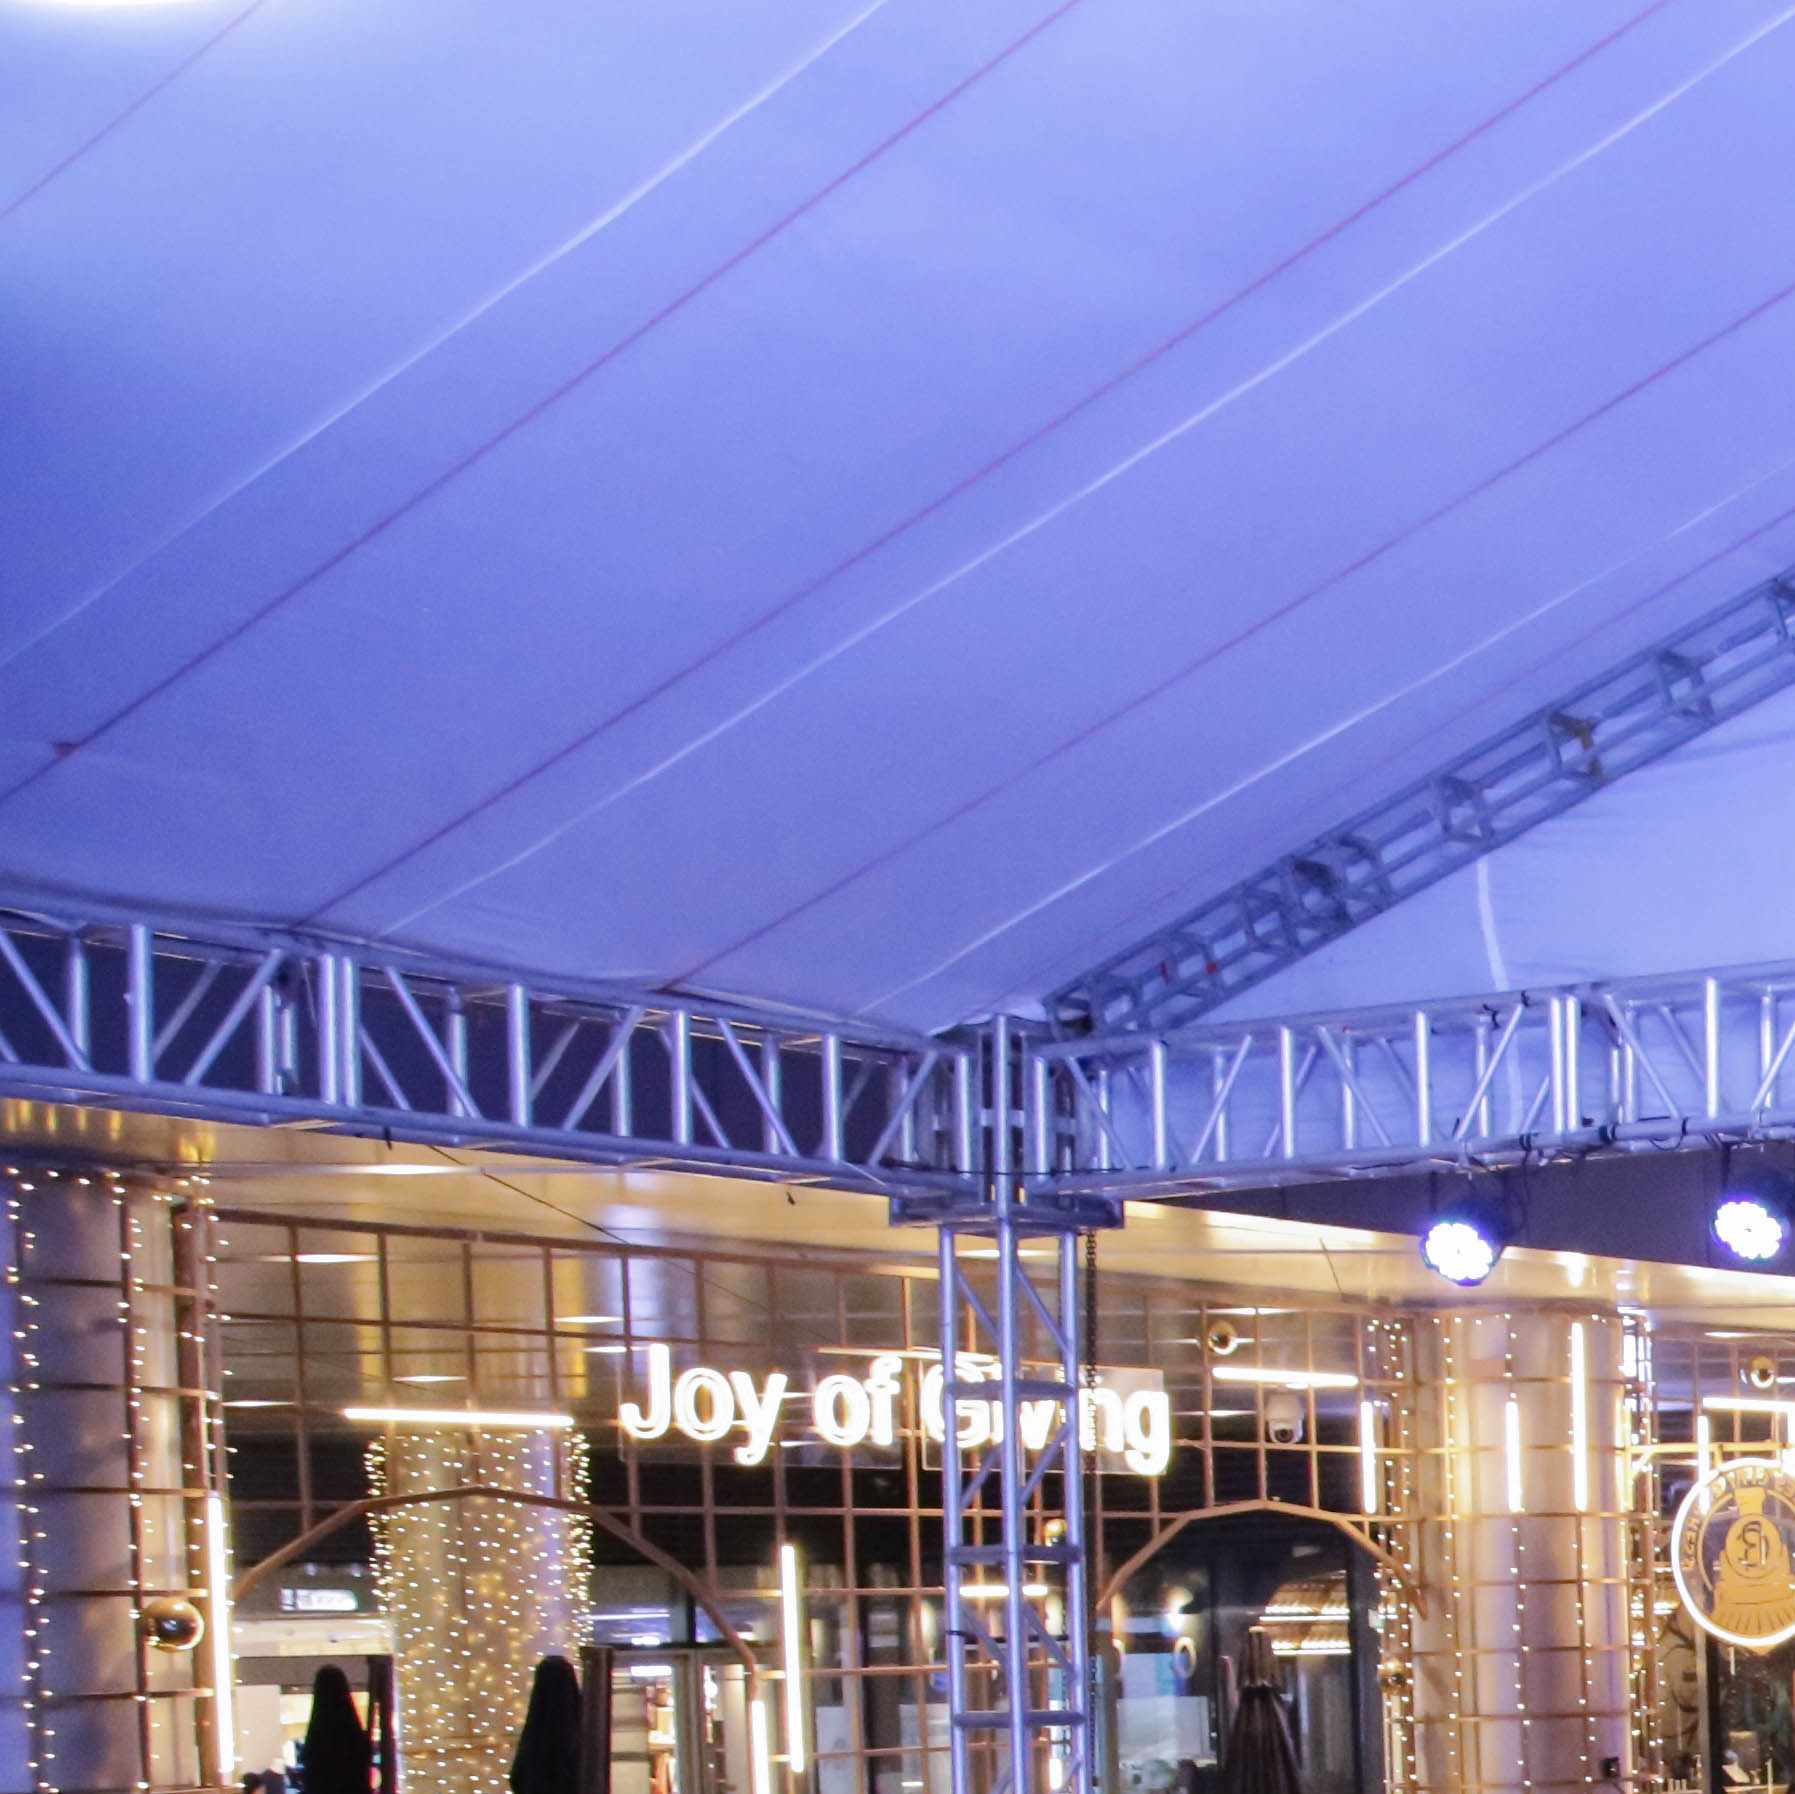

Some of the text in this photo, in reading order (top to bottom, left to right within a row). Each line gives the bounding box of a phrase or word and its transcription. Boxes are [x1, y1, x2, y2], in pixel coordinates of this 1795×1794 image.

[619, 1344, 1170, 1476] Joy of Givng
